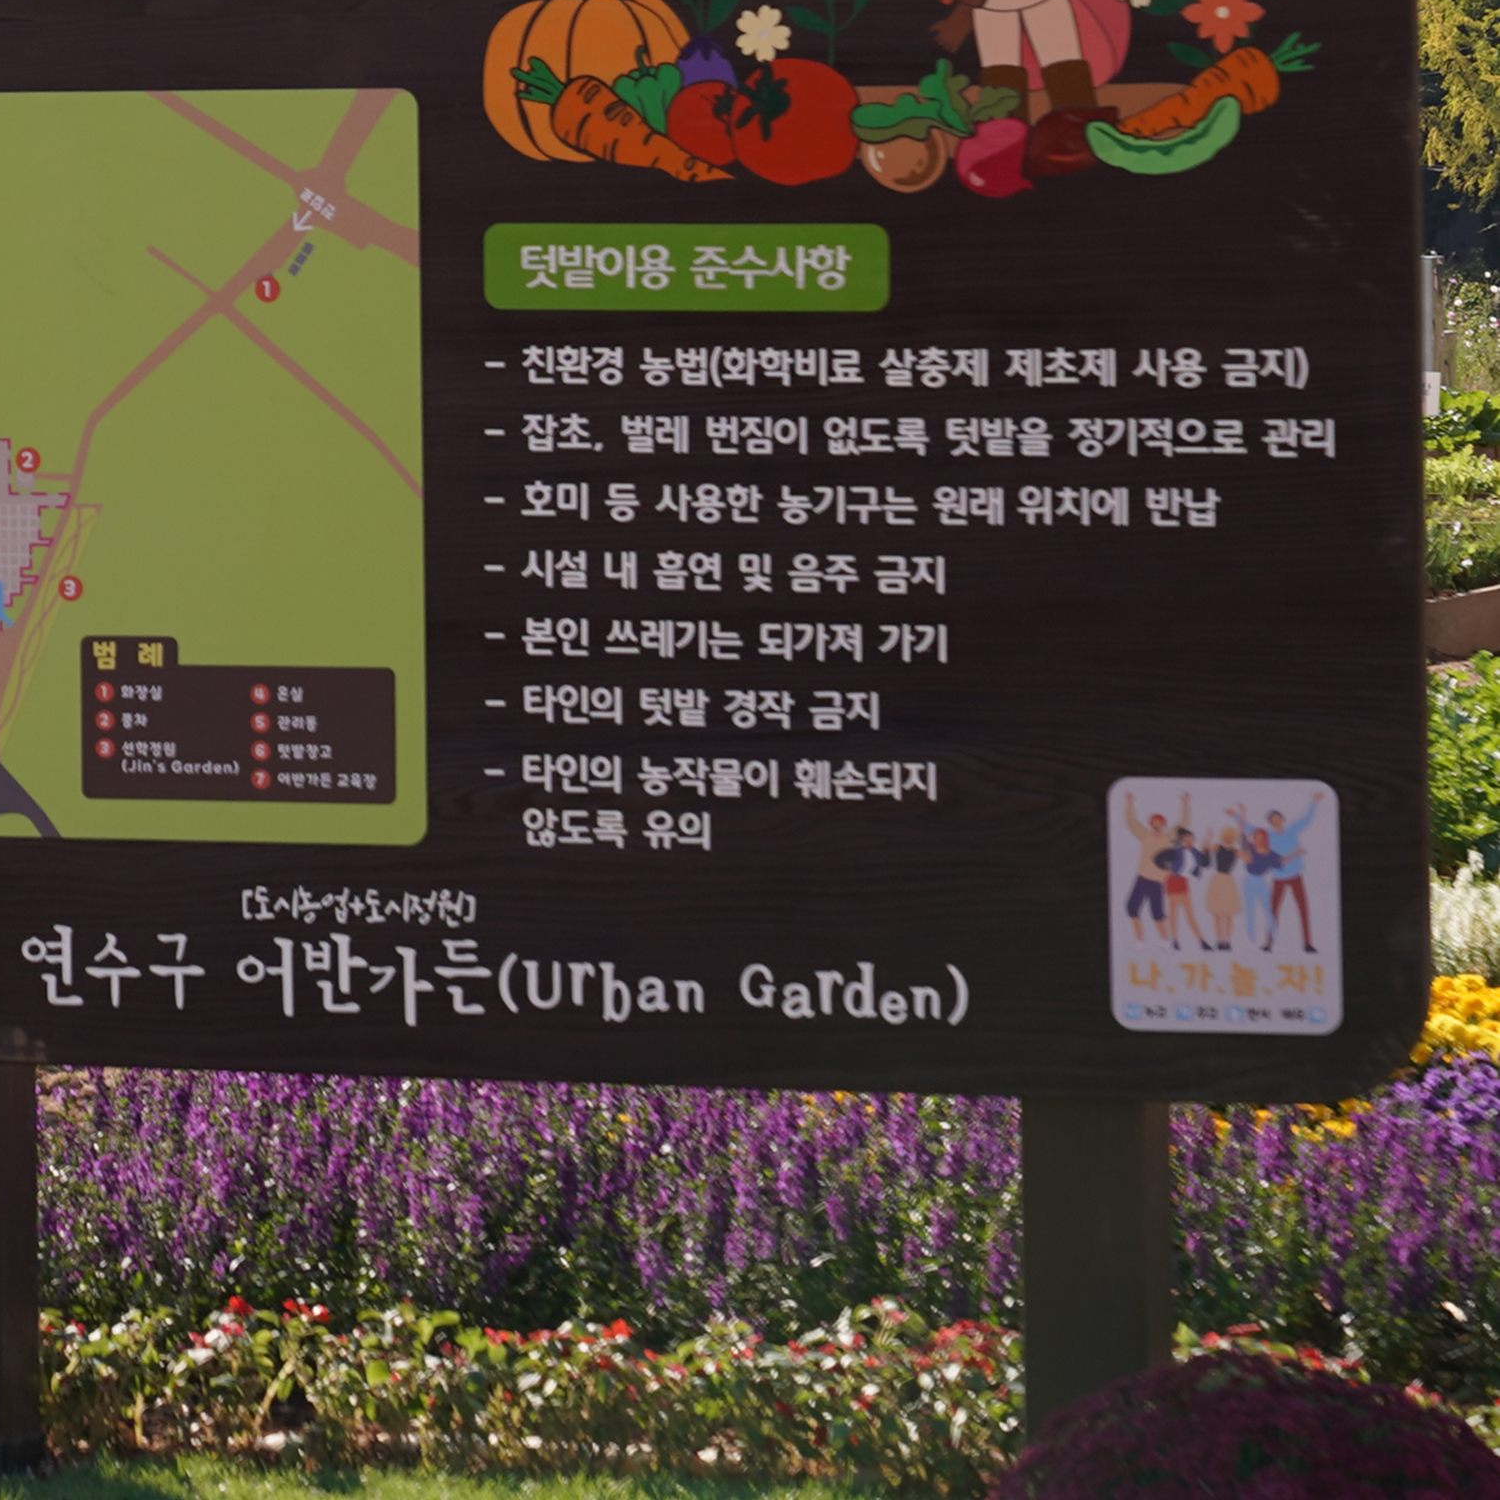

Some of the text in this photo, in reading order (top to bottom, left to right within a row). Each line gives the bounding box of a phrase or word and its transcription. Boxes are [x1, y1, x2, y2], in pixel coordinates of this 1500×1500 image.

[521, 245, 851, 290] 텃밭이용 준수사항
[262, 280, 271, 298] 1
[522, 346, 623, 385] 친환경
[879, 347, 988, 388] 살충제
[1005, 347, 1116, 387] 제초제
[1133, 348, 1207, 388] 사용
[1222, 347, 1308, 389] 금지)
[522, 413, 1335, 457] 잡초, 벌레 번짐이 없도록 텃밭을 정기적으로 관리
[21, 451, 33, 467] 2
[521, 481, 1221, 527] 호미 등 사용한 농기구는 원래 위치에 반납
[522, 550, 945, 594] 시설 내 흡연 및 음주 금지
[63, 579, 77, 597] 3
[522, 618, 947, 663] 본인 쓰레기는 되가져 가기
[100, 684, 163, 702] 1 화장실
[254, 687, 265, 700] 4
[524, 685, 879, 730] 타인의 텃밭 경작 금지
[100, 713, 109, 727] 2
[254, 715, 317, 733] 5 관리동
[100, 740, 177, 758] 3 선학정원
[254, 743, 332, 760] 6 텃밭창고
[121, 758, 240, 775] (Jin's Garden)
[255, 772, 377, 790] 7 어반가든 교육장
[523, 754, 936, 800] 타인의 농작물이 훼손되지
[523, 808, 710, 850] 않도록 유의
[22, 925, 205, 1009] 연수구
[740, 962, 968, 1025] Garden)
